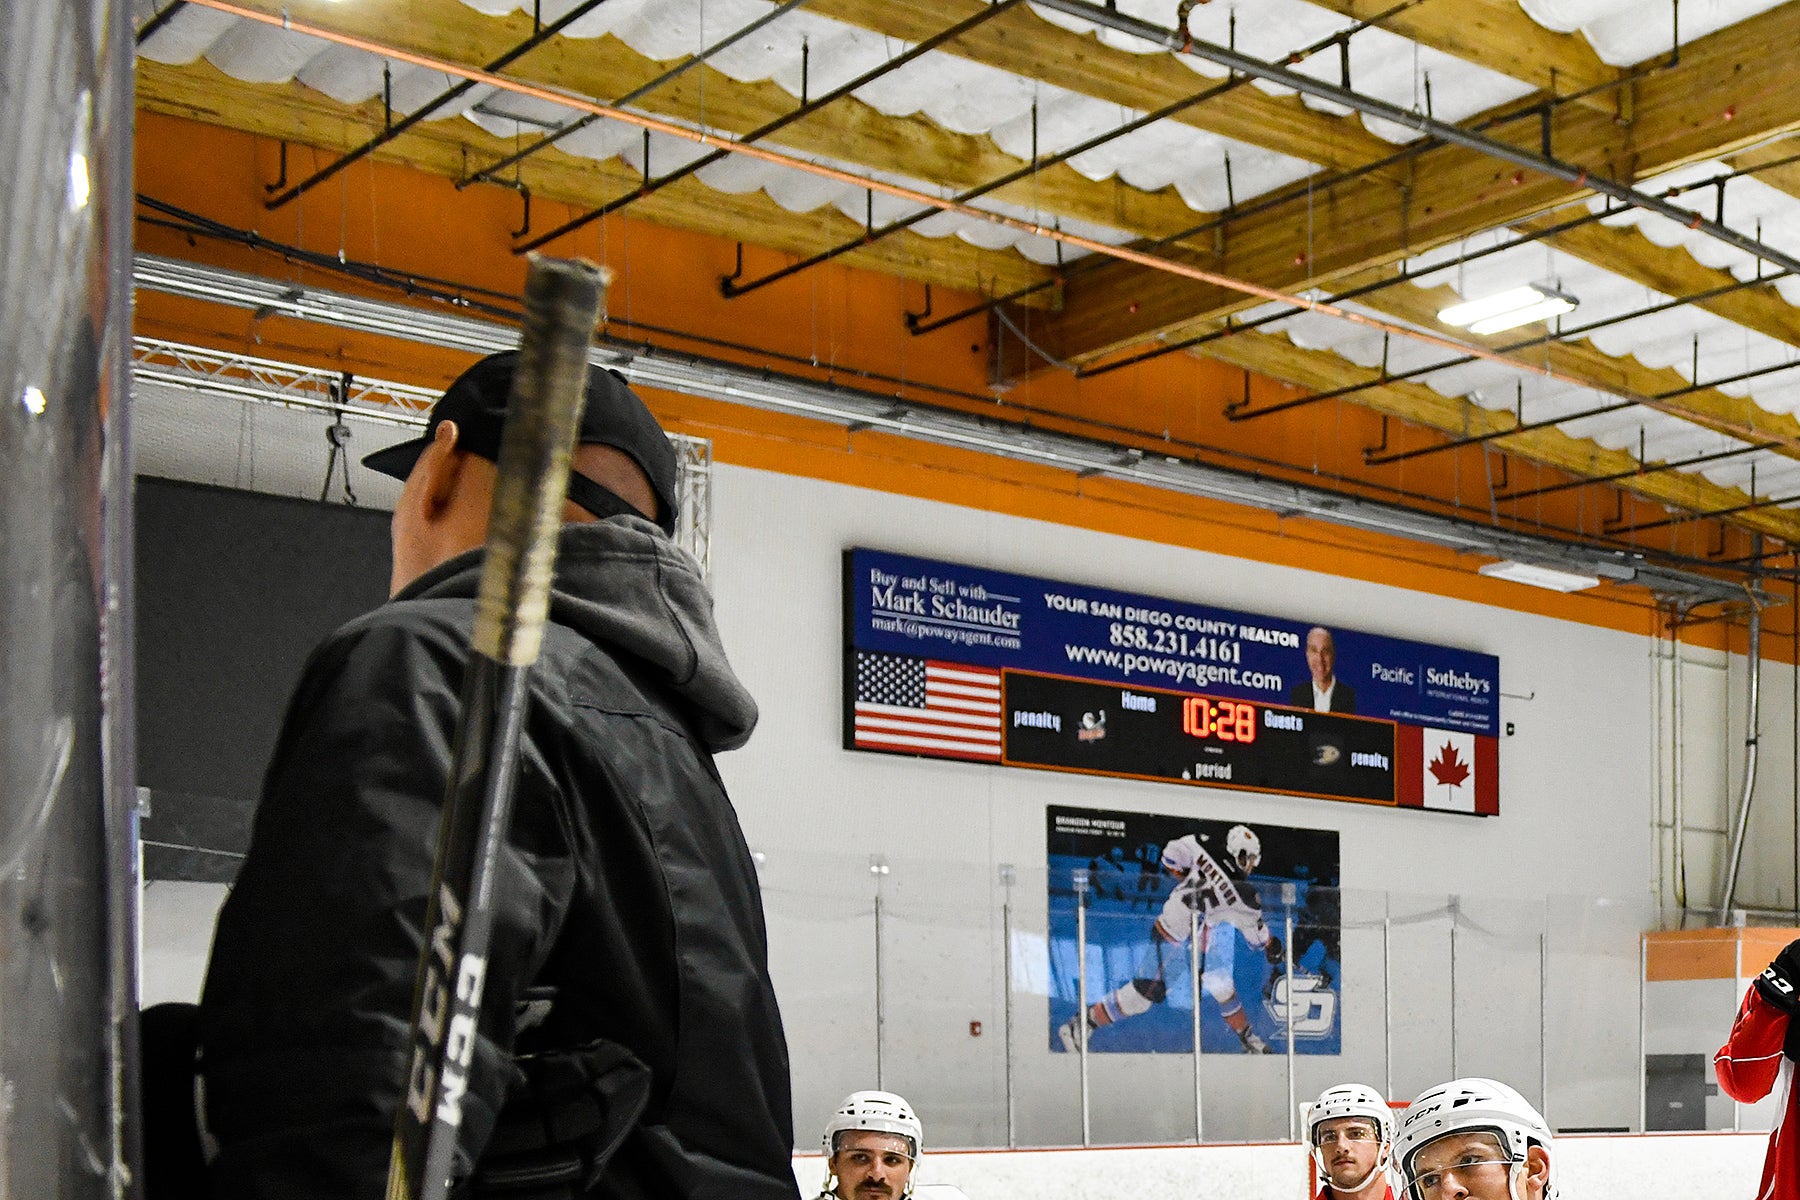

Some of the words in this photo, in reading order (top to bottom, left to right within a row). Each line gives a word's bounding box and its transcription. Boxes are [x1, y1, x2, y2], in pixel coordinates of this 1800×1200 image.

[870, 568, 898, 590] Buy
[901, 575, 927, 592] and
[929, 577, 955, 596] Sell
[958, 584, 987, 602] with
[871, 585, 927, 615] Mark
[931, 594, 1021, 629] Schauder
[1043, 592, 1088, 615] YOUR
[1090, 601, 1121, 620] SAN
[1124, 606, 1173, 628] DIEGO
[1174, 614, 1237, 638] COUNTY
[1239, 624, 1300, 648] REALTOR
[871, 617, 1022, 650] mark@powayagent.com
[1109, 622, 1241, 665] 858.231.4161
[1065, 643, 1283, 692] www.powayagent.com
[1371, 662, 1415, 686] Pacific
[1426, 667, 1491, 695] Sotheby's
[1121, 690, 1157, 713] Home
[1013, 710, 1062, 733] penalty
[1182, 697, 1257, 744] 10:28
[1264, 709, 1304, 732] Guests
[1194, 761, 1233, 780] period
[1350, 751, 1390, 772] penalty
[1197, 854, 1238, 906] MONTOUR
[436, 952, 489, 1127] CCM
[1404, 1104, 1441, 1127] CCM
